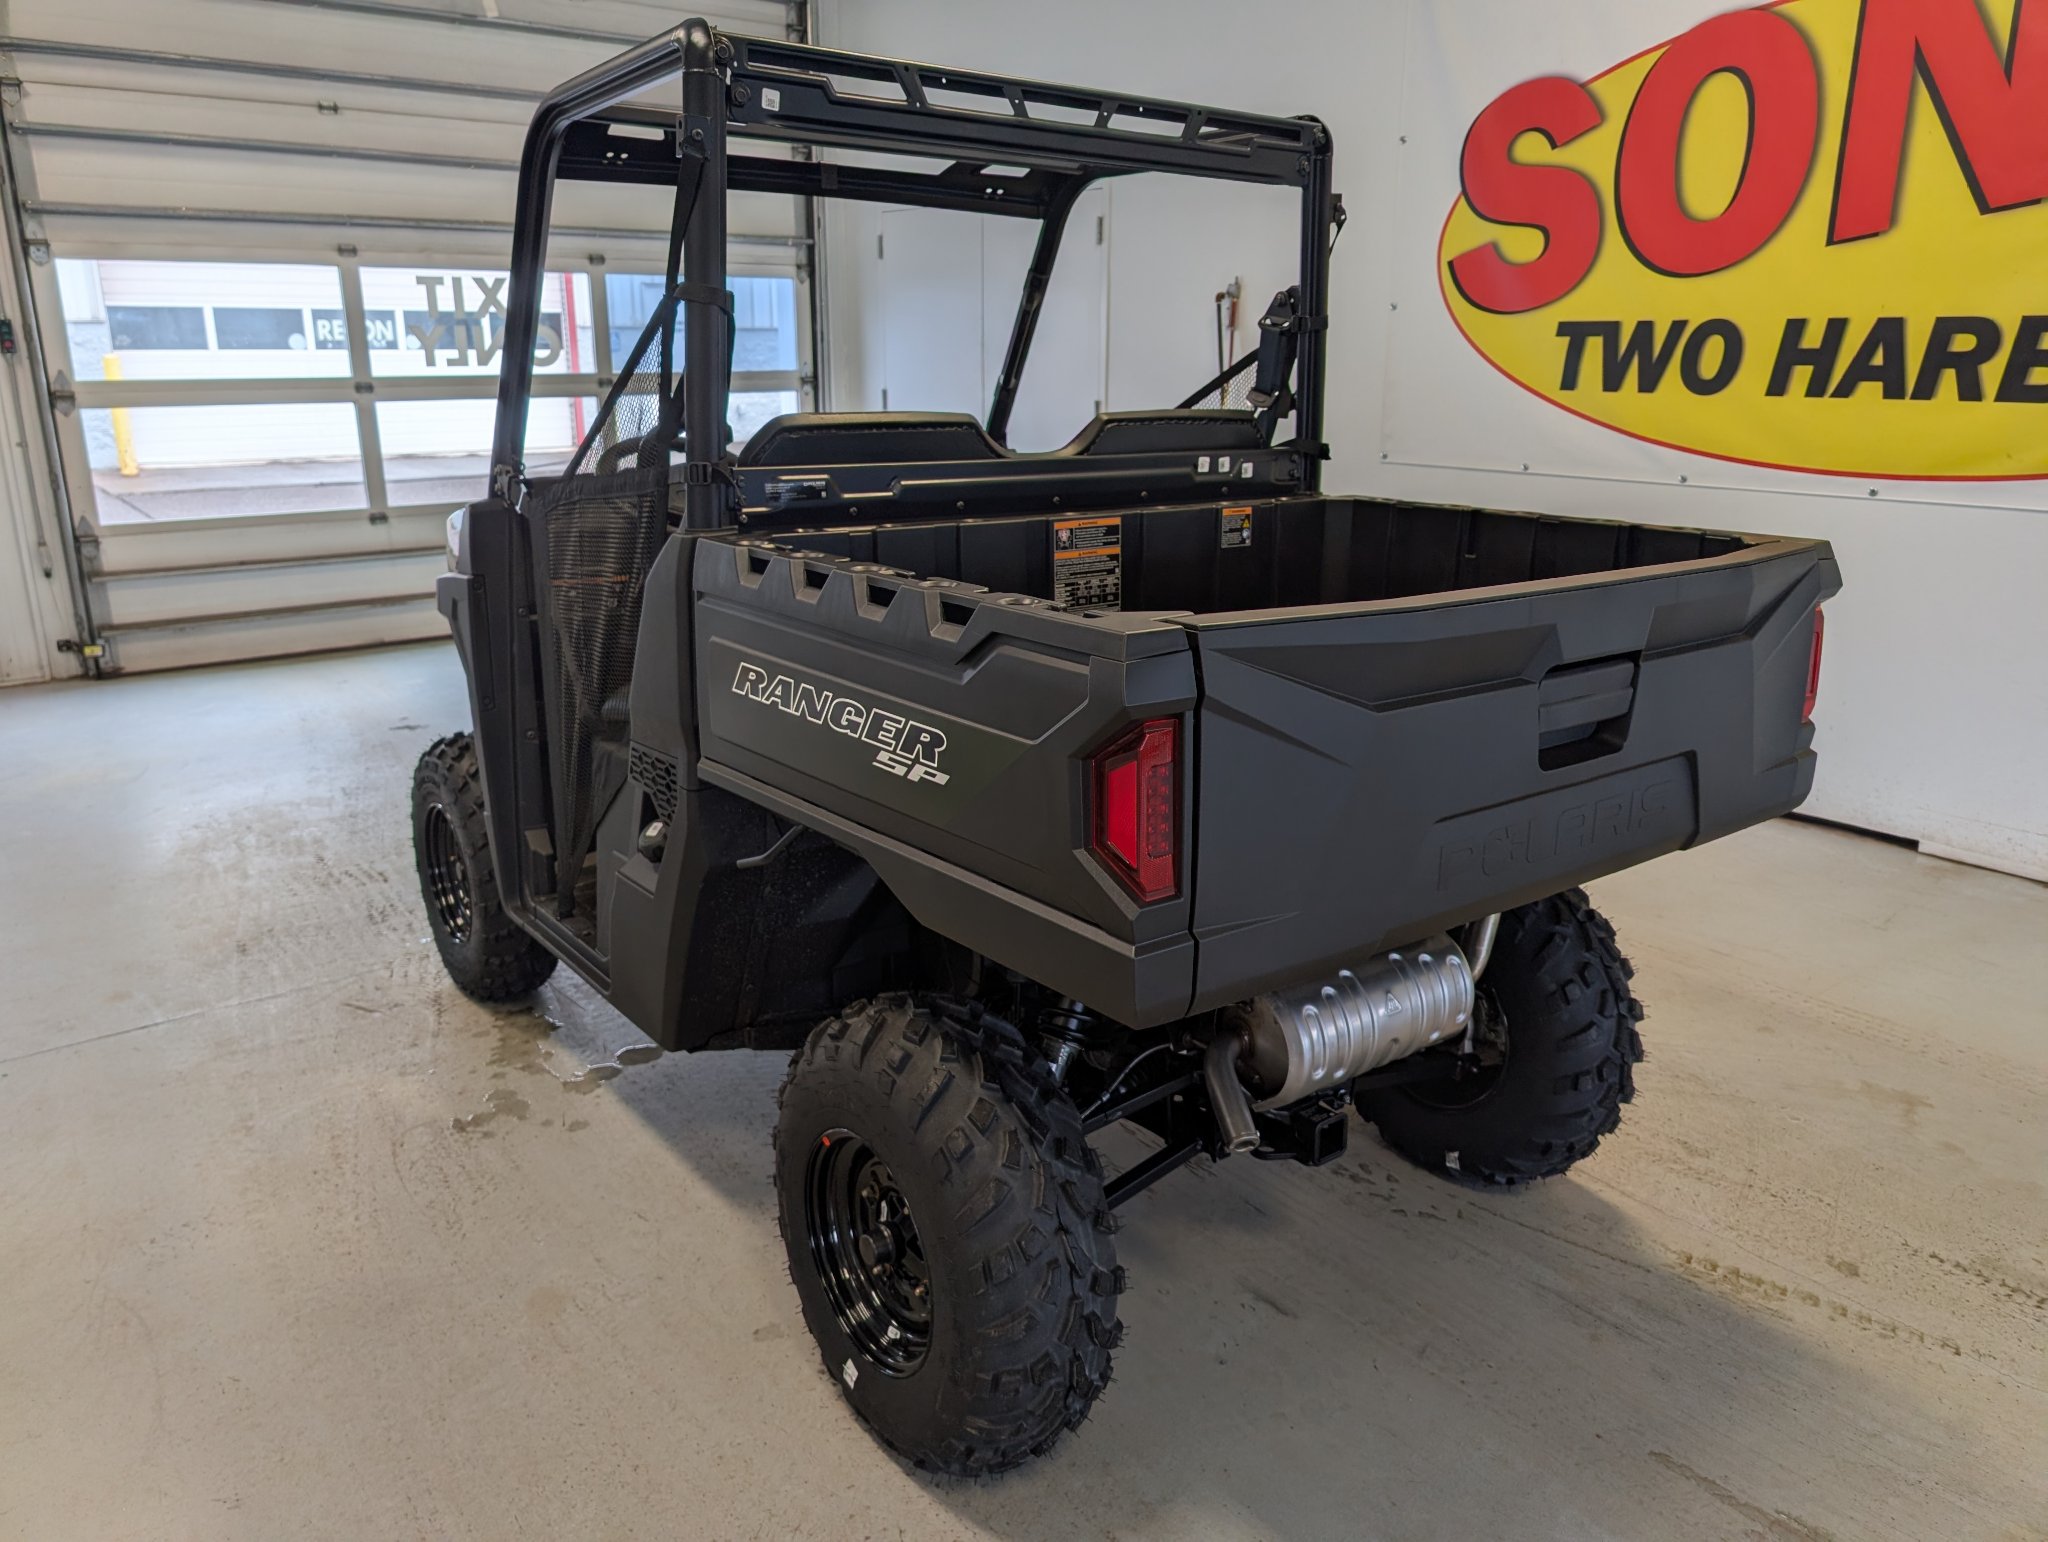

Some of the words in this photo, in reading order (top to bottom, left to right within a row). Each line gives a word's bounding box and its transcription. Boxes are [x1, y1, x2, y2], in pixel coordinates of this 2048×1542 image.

[1555, 318, 1743, 397] TWO
[732, 661, 947, 767] RANGER
[872, 750, 951, 786] SP
[1436, 778, 1672, 893] POLARIS
